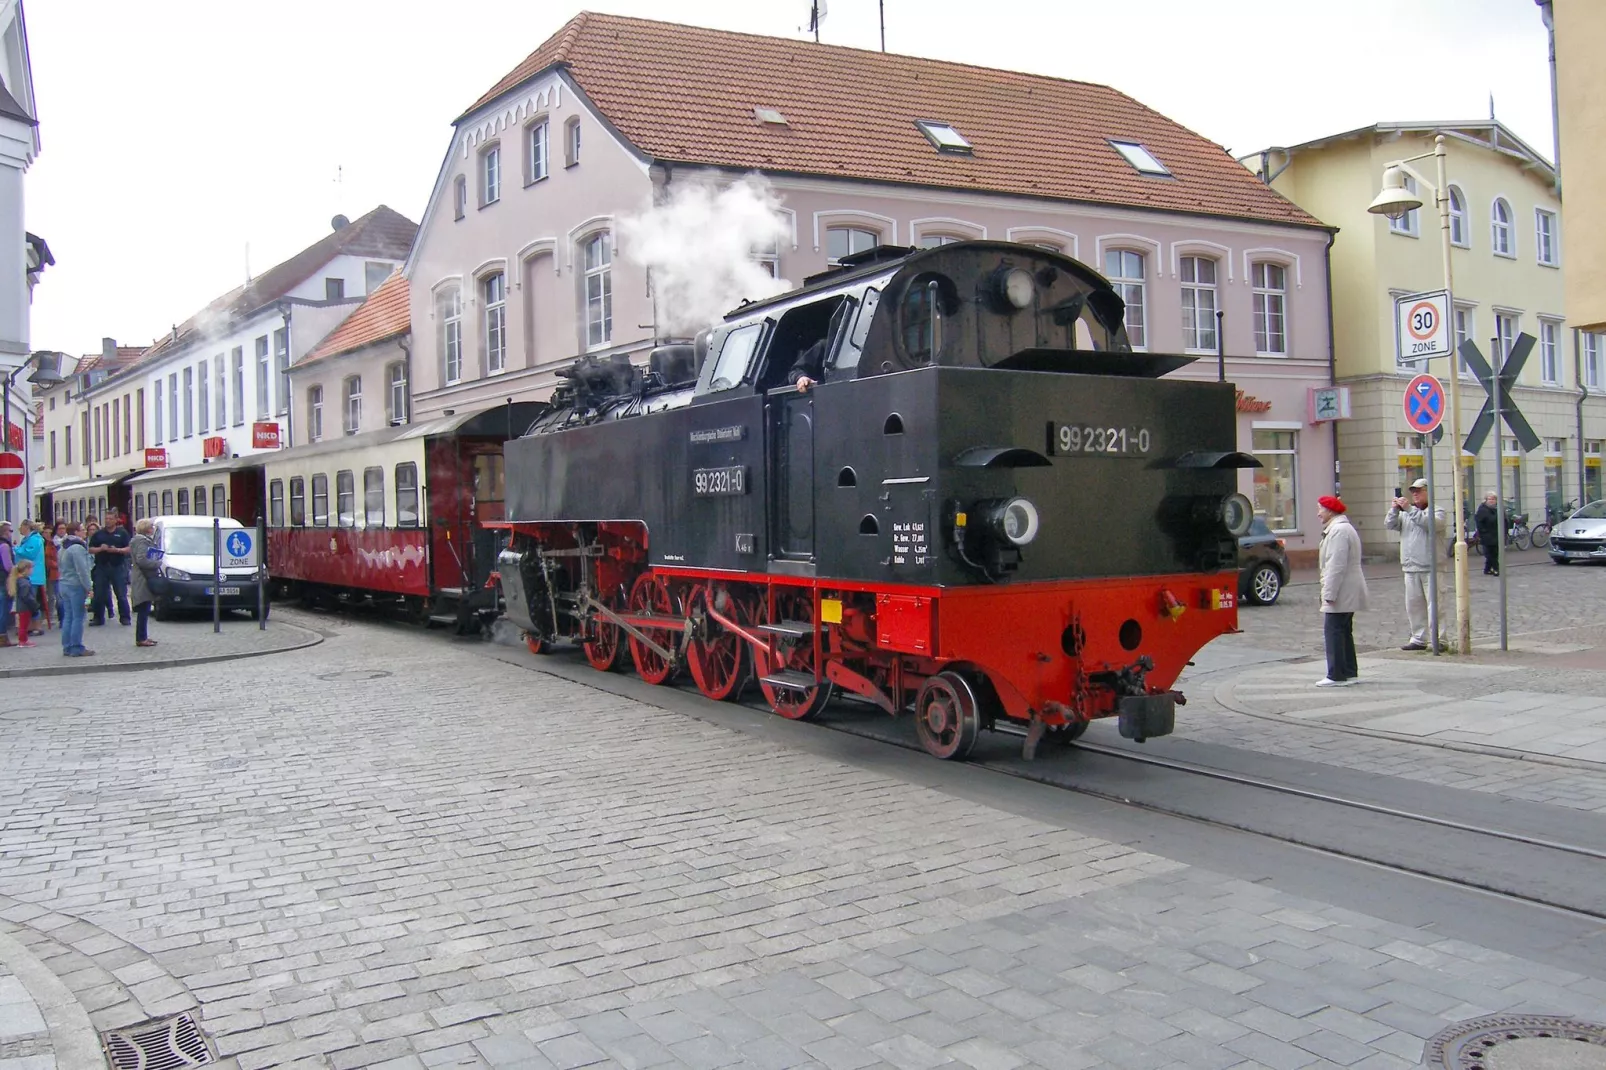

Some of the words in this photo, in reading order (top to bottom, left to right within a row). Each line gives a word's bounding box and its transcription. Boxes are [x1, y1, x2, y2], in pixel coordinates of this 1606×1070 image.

[1414, 312, 1433, 330] 30
[1412, 341, 1437, 353] ZONE
[256, 432, 278, 440] NKD
[1060, 426, 1081, 452] 99
[1084, 427, 1150, 452] 2321-0
[695, 473, 707, 493] 99
[735, 535, 741, 552] K
[229, 558, 249, 566] ZONE
